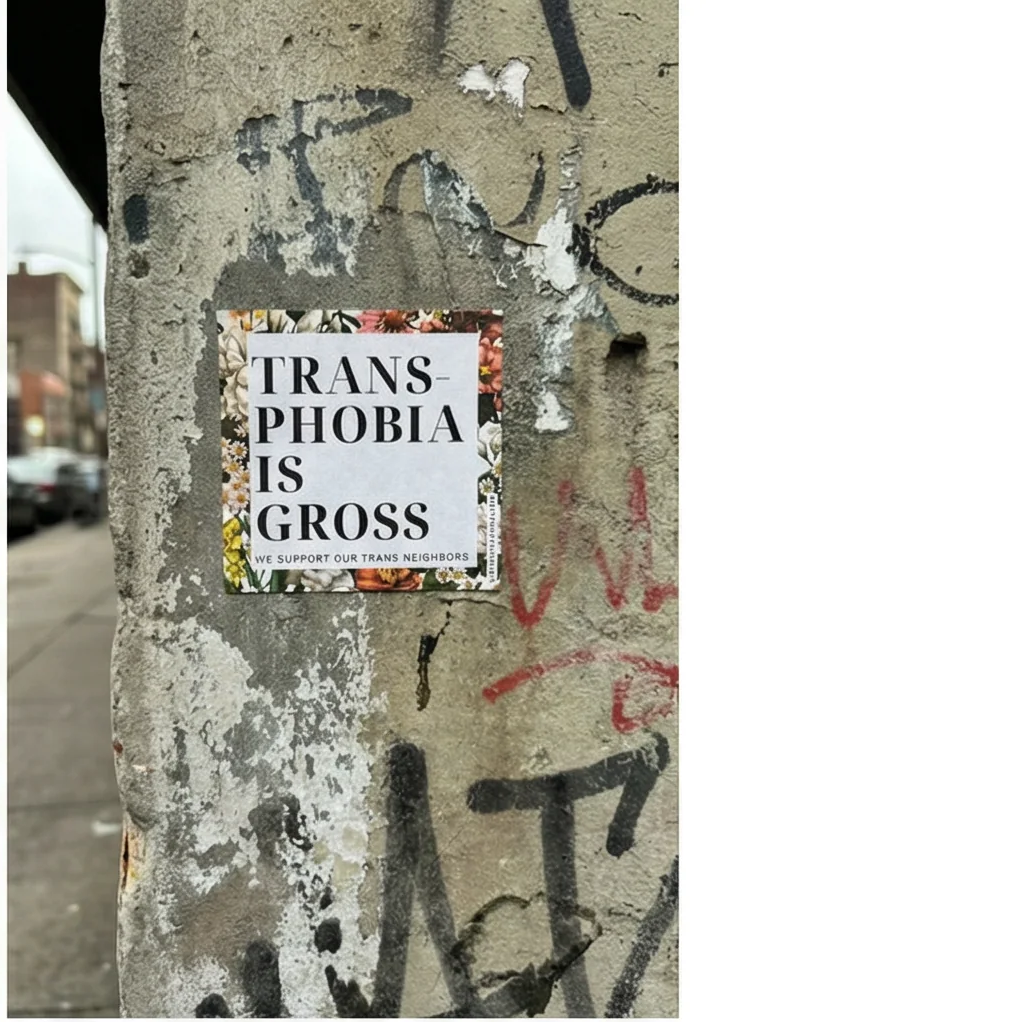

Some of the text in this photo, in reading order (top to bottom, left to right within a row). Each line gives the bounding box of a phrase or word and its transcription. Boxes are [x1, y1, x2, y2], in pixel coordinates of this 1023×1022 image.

[252, 356, 450, 395] TRANS-
[254, 404, 464, 444] PHOBIA
[255, 455, 304, 493] IS
[257, 502, 429, 542] GROSS
[255, 552, 469, 564] WE SUPPORT OUR TRANS NEIGHBORS
